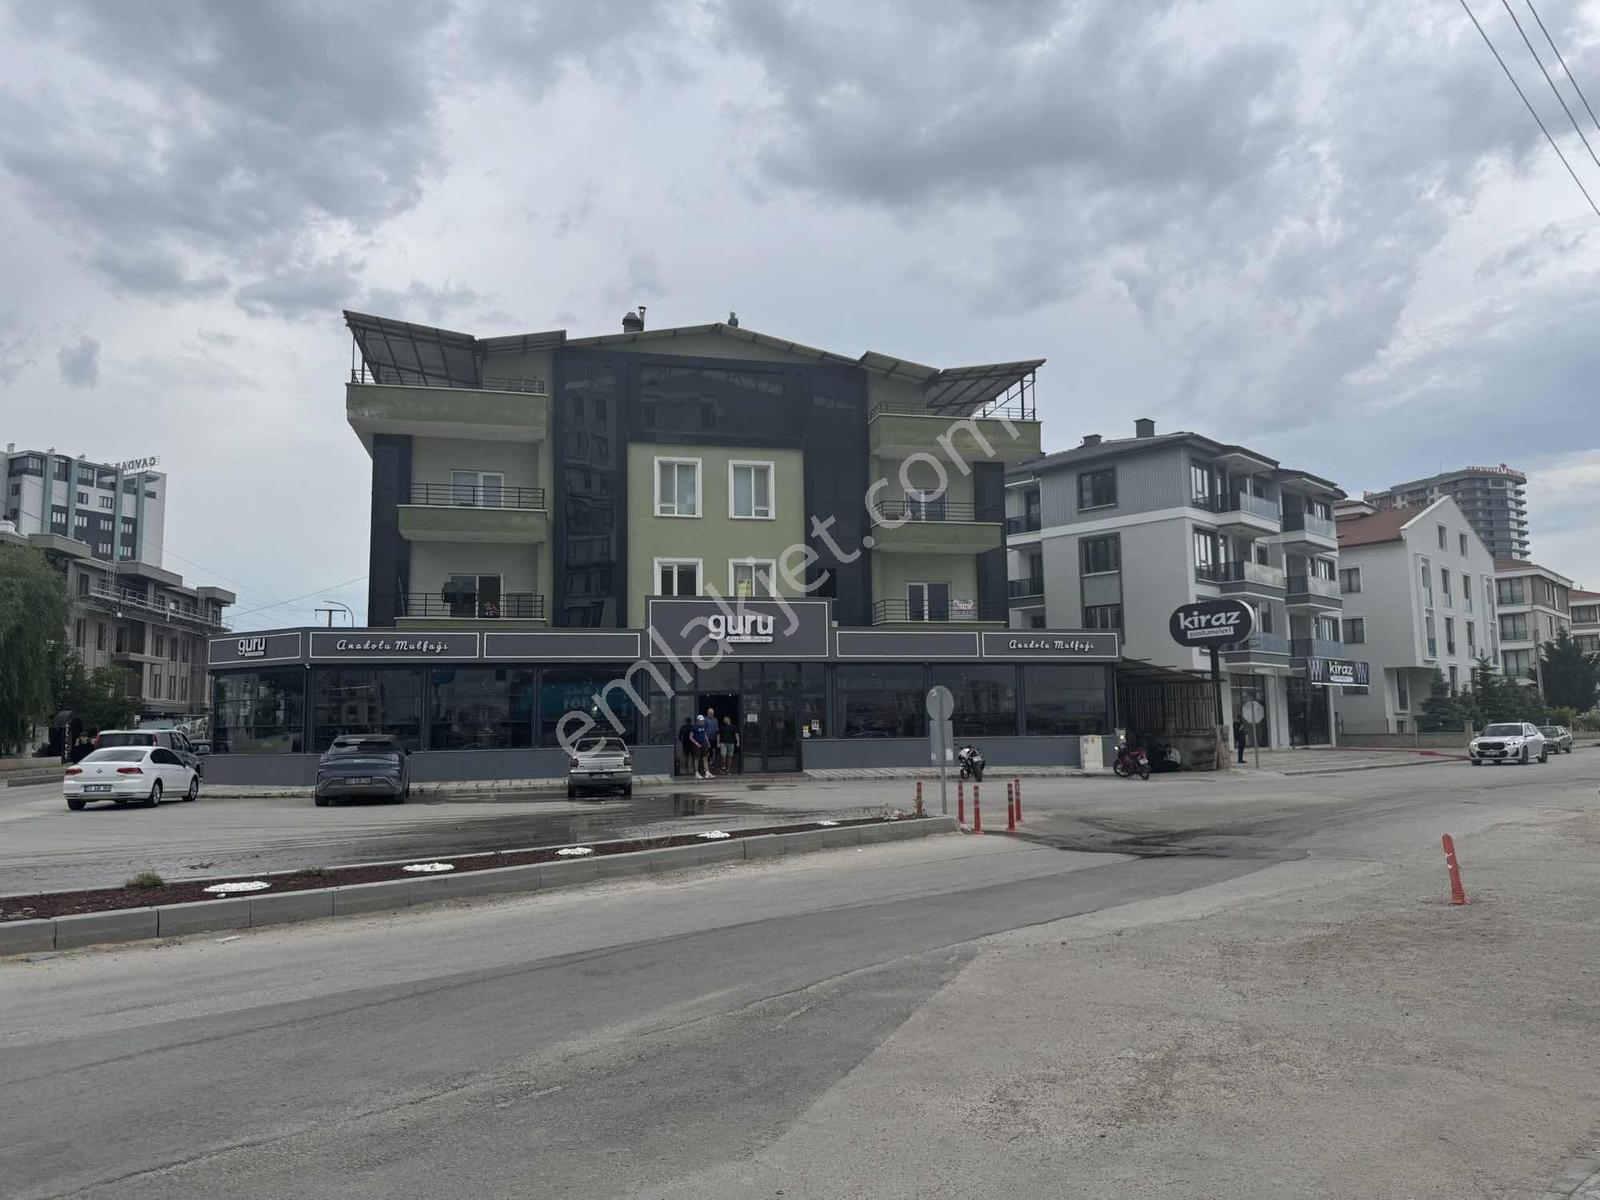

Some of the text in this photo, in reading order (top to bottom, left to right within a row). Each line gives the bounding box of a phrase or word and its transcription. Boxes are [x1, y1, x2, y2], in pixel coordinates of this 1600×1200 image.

[708, 614, 774, 640] guru
[1178, 610, 1240, 630] kiraz
[237, 637, 266, 656] guru
[336, 640, 391, 650] Anadolu
[1009, 639, 1050, 649] Anadolu
[1328, 660, 1353, 675] kiraz
